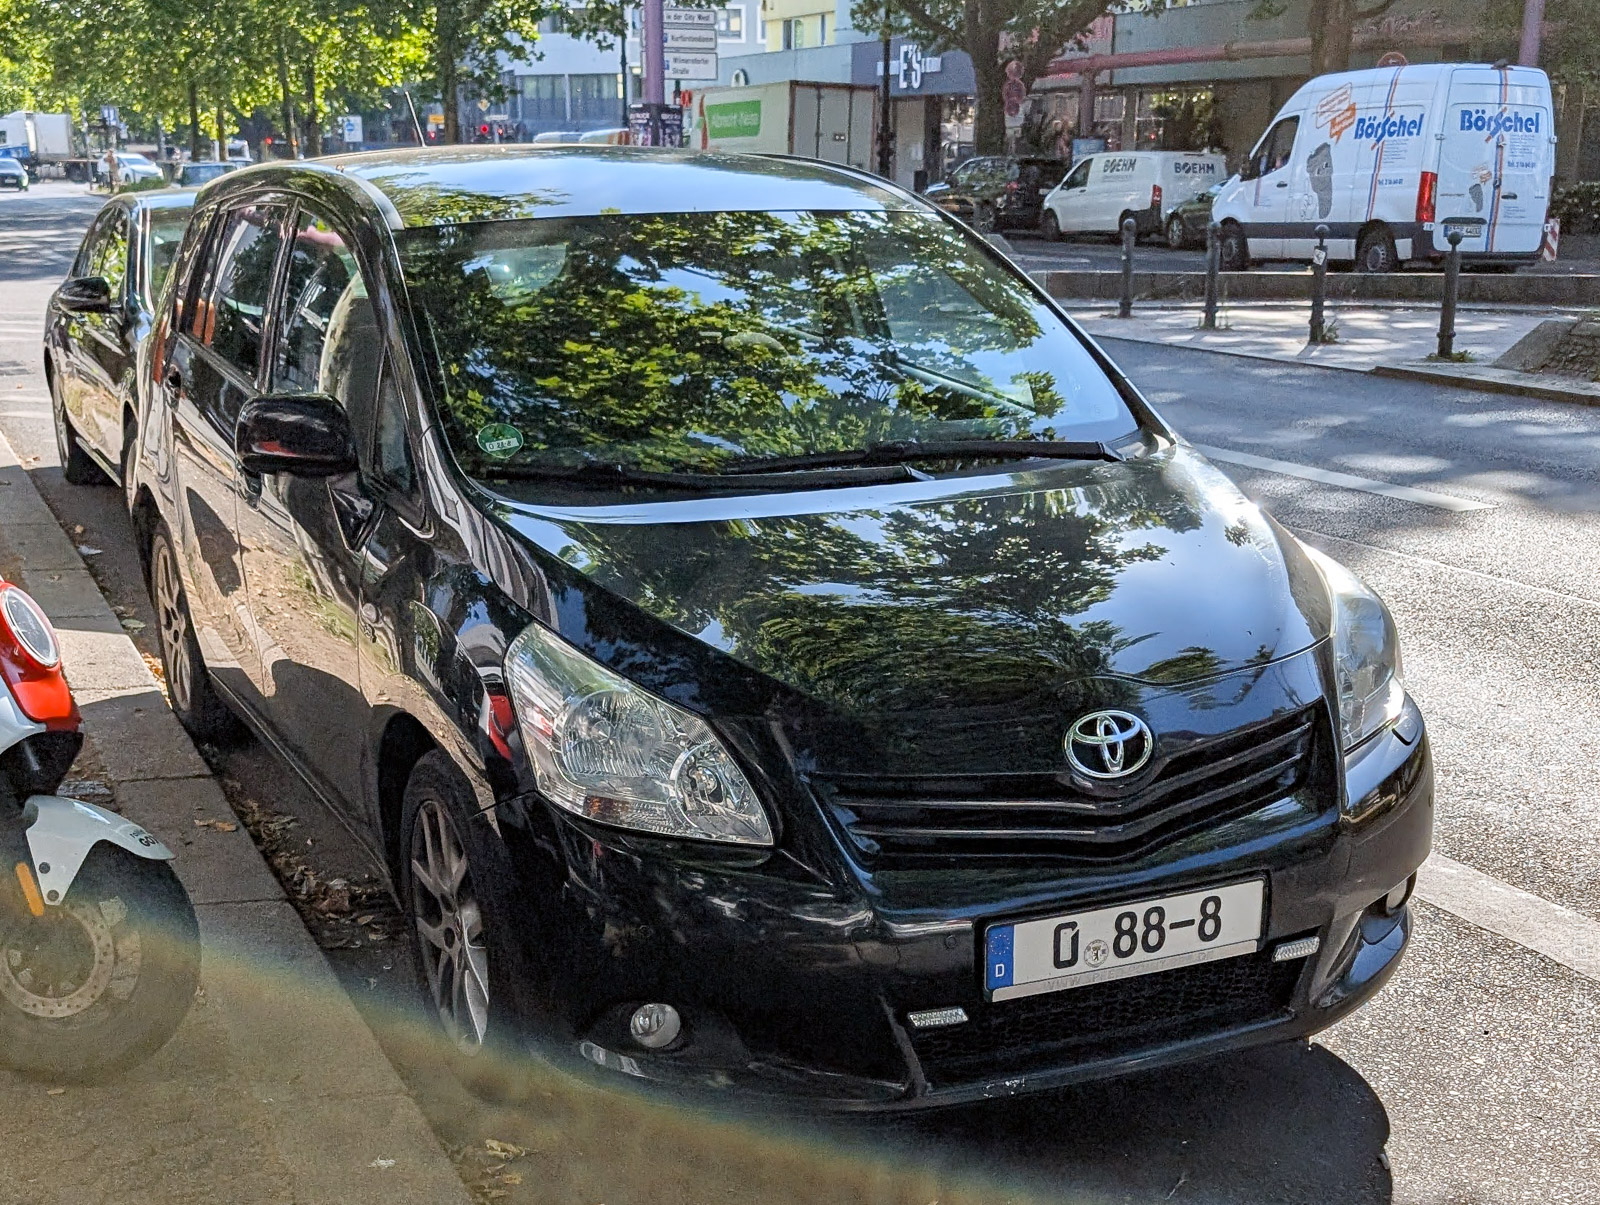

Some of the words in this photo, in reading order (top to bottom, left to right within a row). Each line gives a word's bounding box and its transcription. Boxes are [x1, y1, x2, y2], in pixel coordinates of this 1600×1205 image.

[683, 12, 696, 22] City
[1354, 113, 1425, 144] Börschel
[1460, 108, 1540, 141] Börschel
[1112, 895, 1222, 959] 88-8
[995, 963, 1005, 978] D
